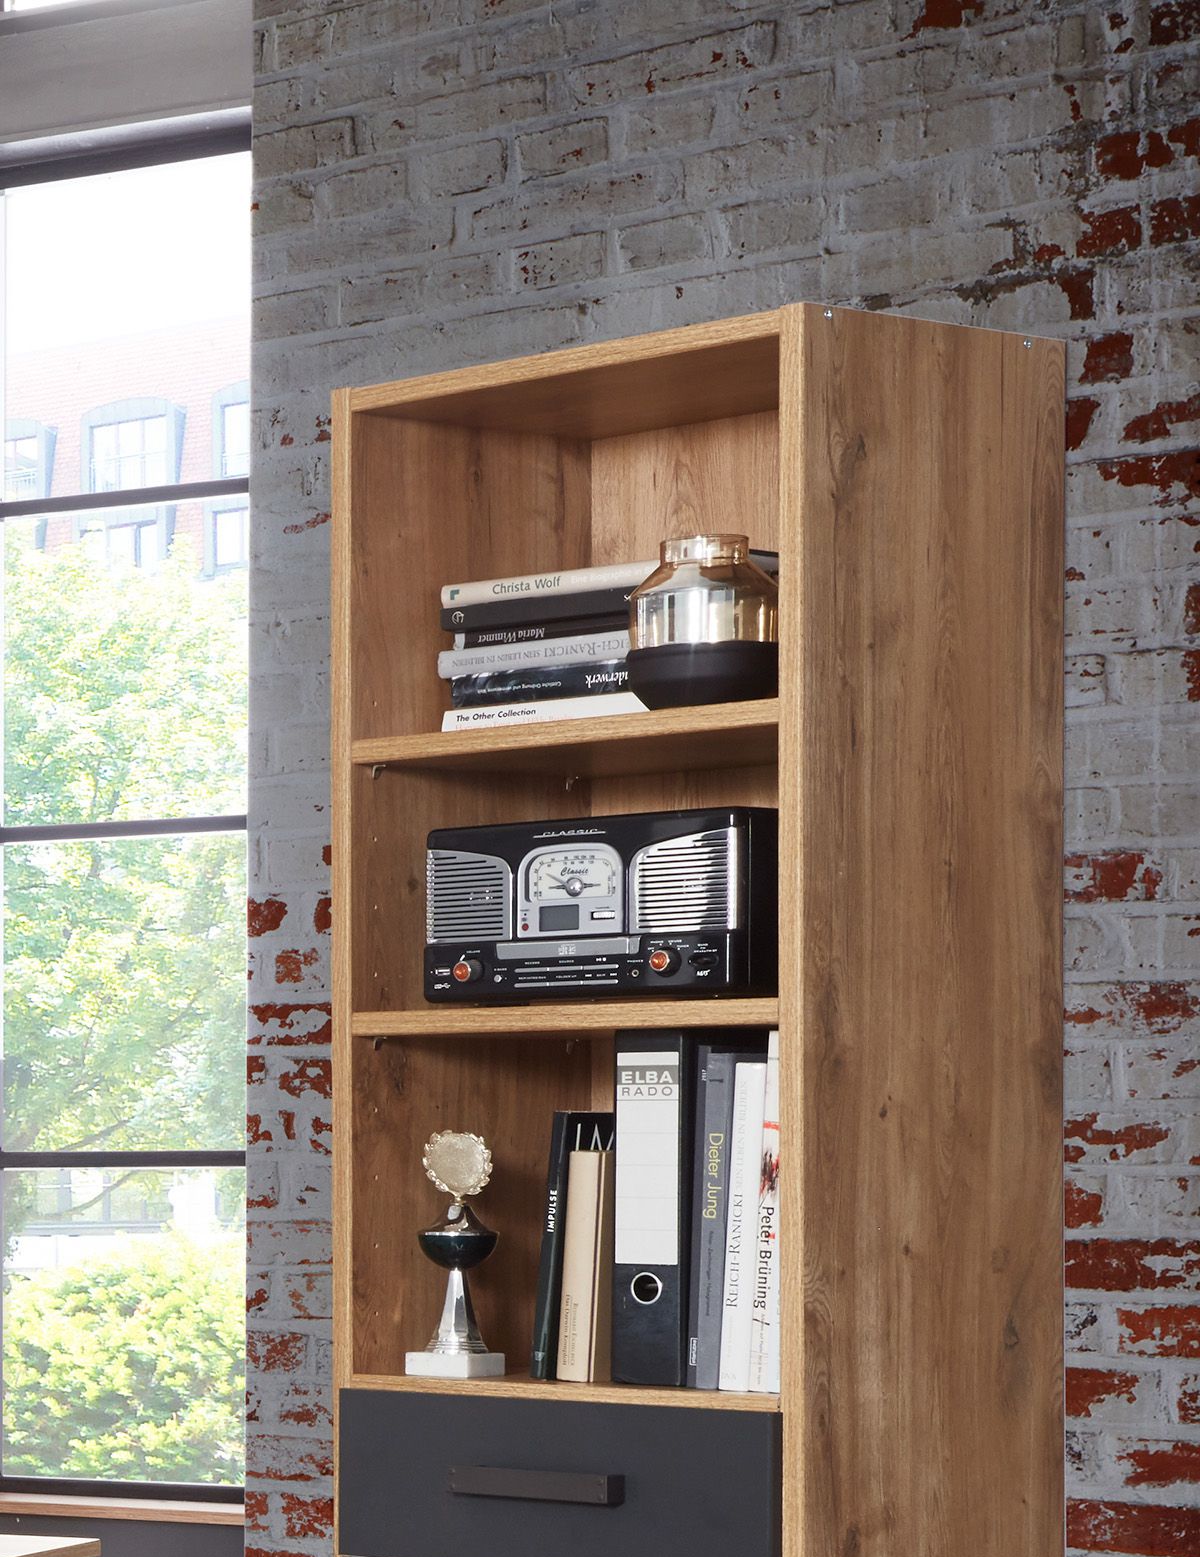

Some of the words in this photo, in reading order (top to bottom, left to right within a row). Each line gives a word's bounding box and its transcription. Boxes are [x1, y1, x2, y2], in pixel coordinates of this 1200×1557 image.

[492, 579, 531, 596] Christa
[535, 575, 561, 591] Wolf
[477, 630, 517, 644] Wimmer
[518, 626, 545, 640] Maria
[456, 714, 470, 723] The
[472, 712, 496, 722] Other
[497, 707, 537, 719] Collection
[542, 828, 598, 838] CLASSIC
[560, 866, 590, 877] Classic
[621, 1070, 674, 1084] ELBA
[621, 1086, 673, 1098] RADO
[707, 1132, 725, 1180] Dieter
[546, 1188, 558, 1233] IMPULSE
[702, 1184, 722, 1220] Jung
[760, 1206, 775, 1246] Peter
[725, 1193, 743, 1309] REICH-RANICKI
[753, 1250, 773, 1310] Brüning
